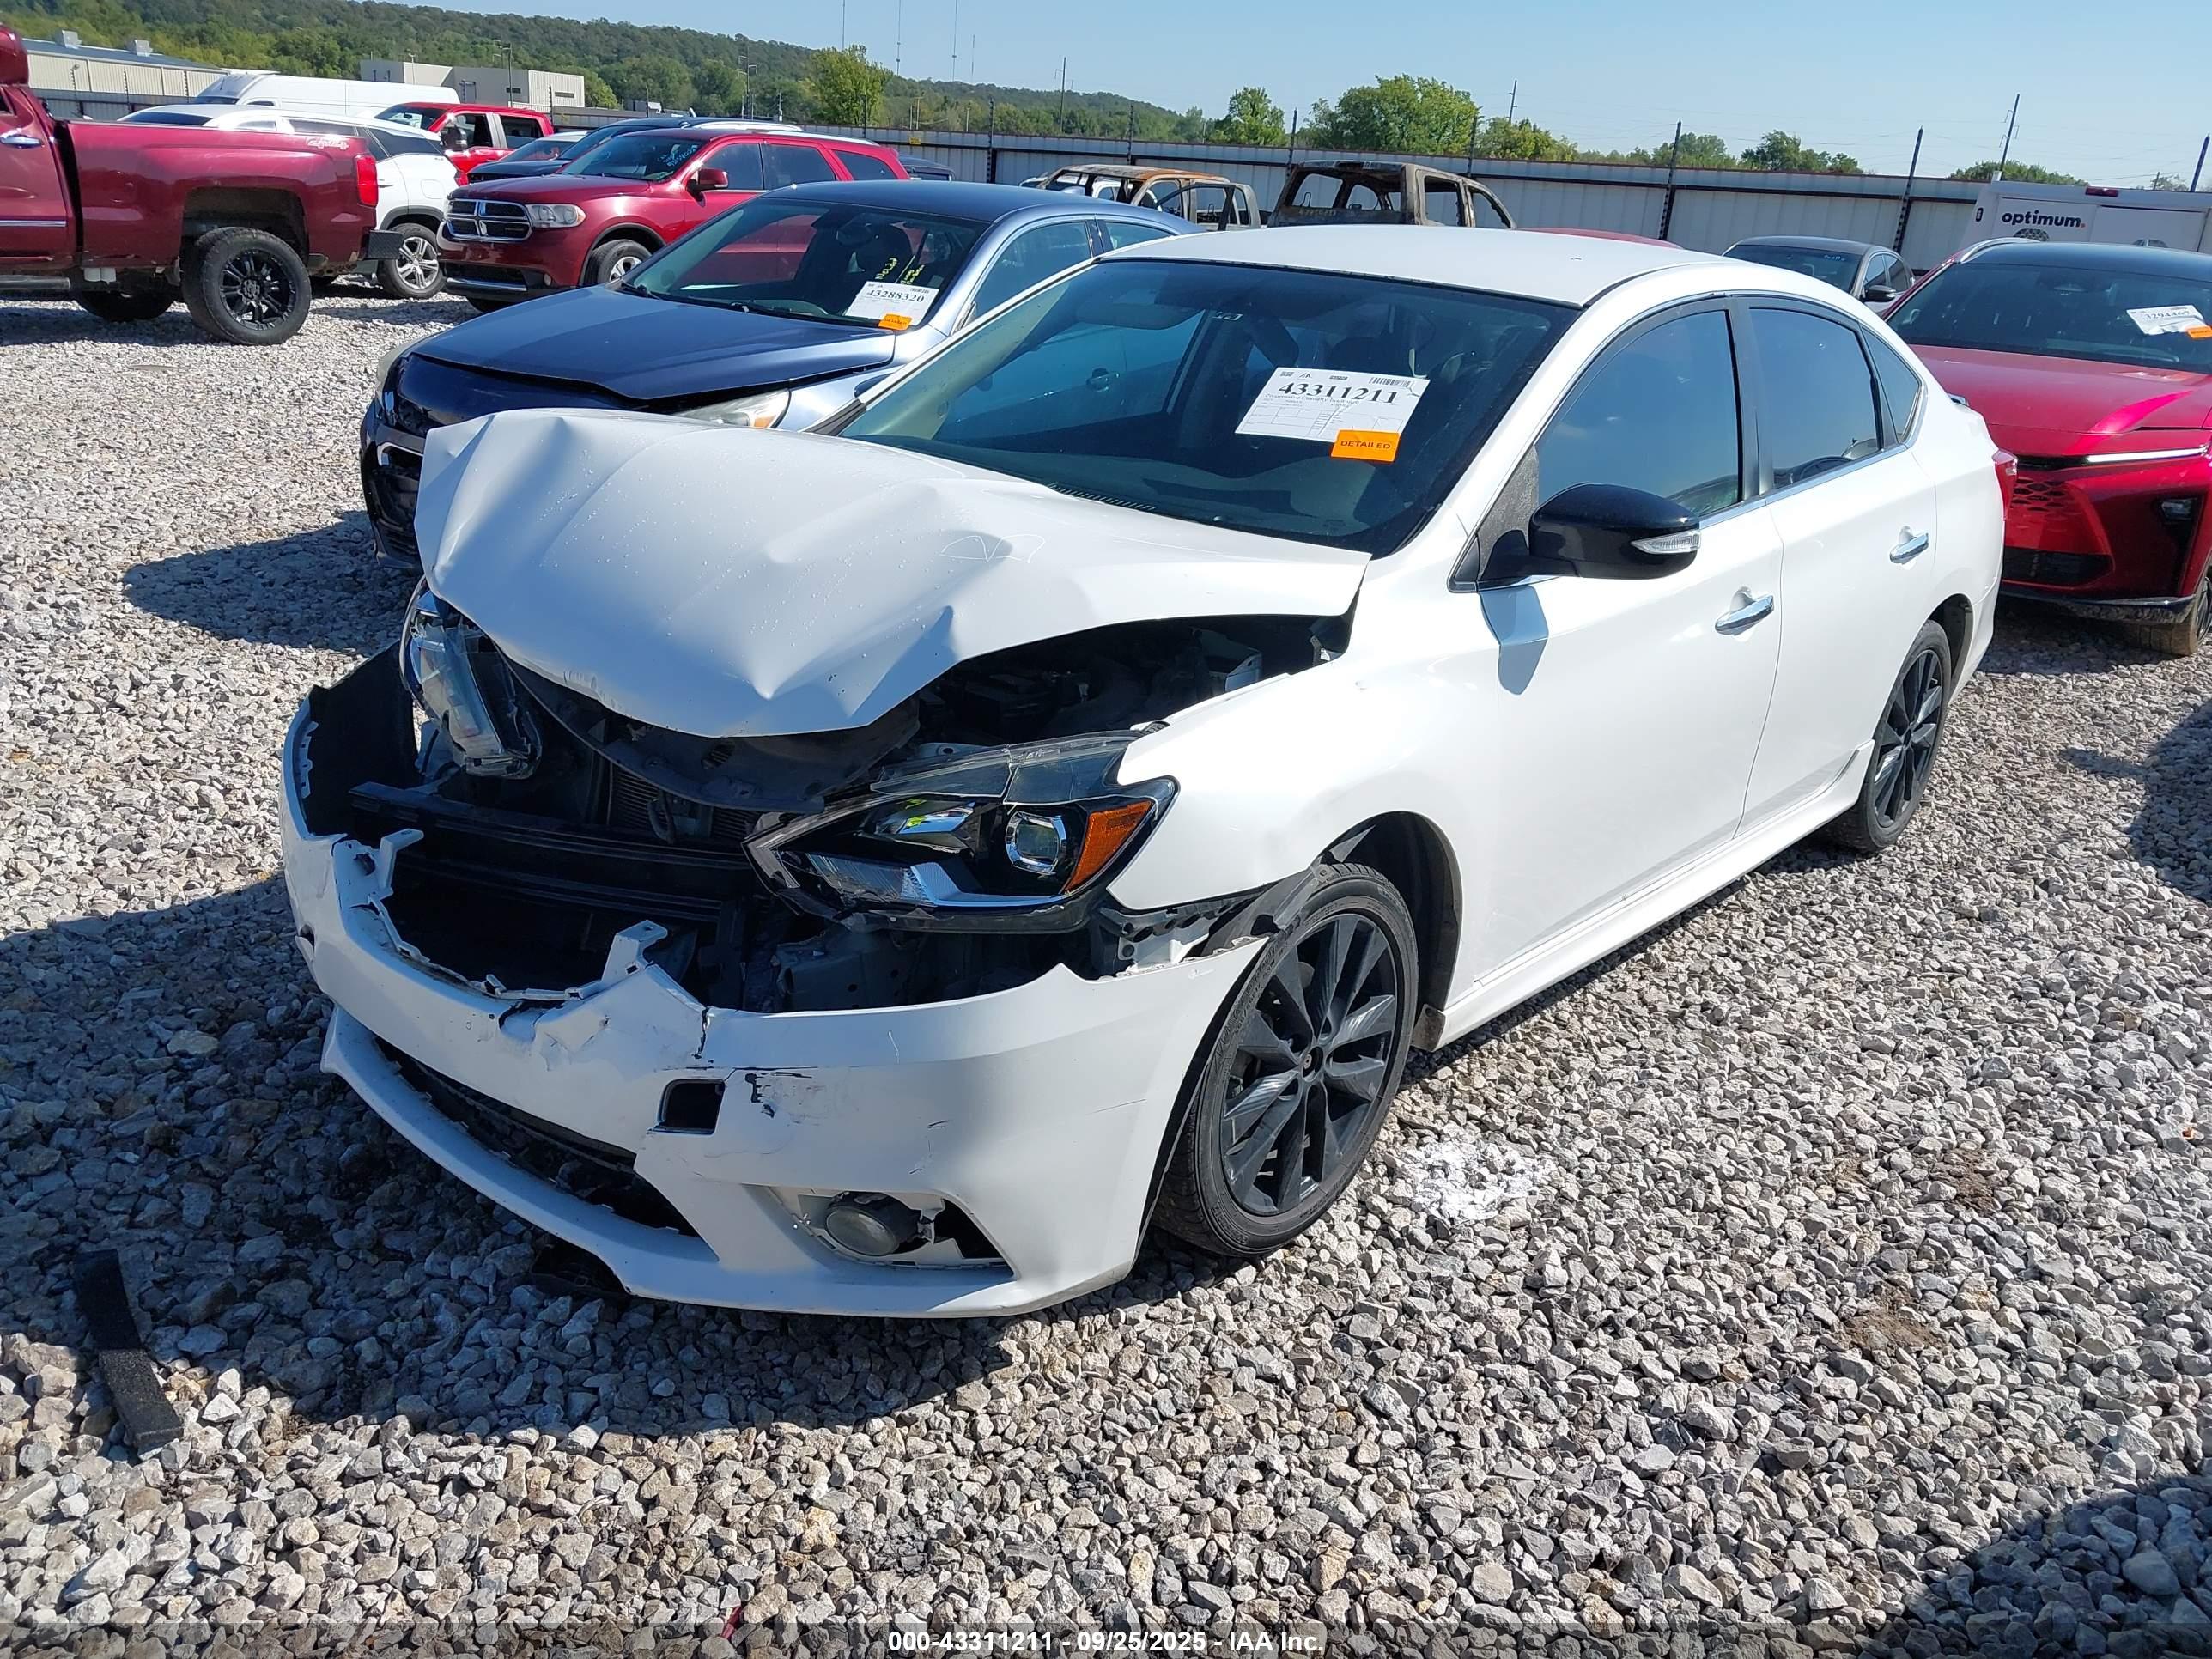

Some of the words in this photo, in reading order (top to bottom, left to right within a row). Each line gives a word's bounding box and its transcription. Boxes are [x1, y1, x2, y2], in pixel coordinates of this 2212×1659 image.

[867, 289, 925, 302] 43288320
[1278, 382, 1398, 404] 43311211
[1340, 440, 1391, 449] DETAILED
